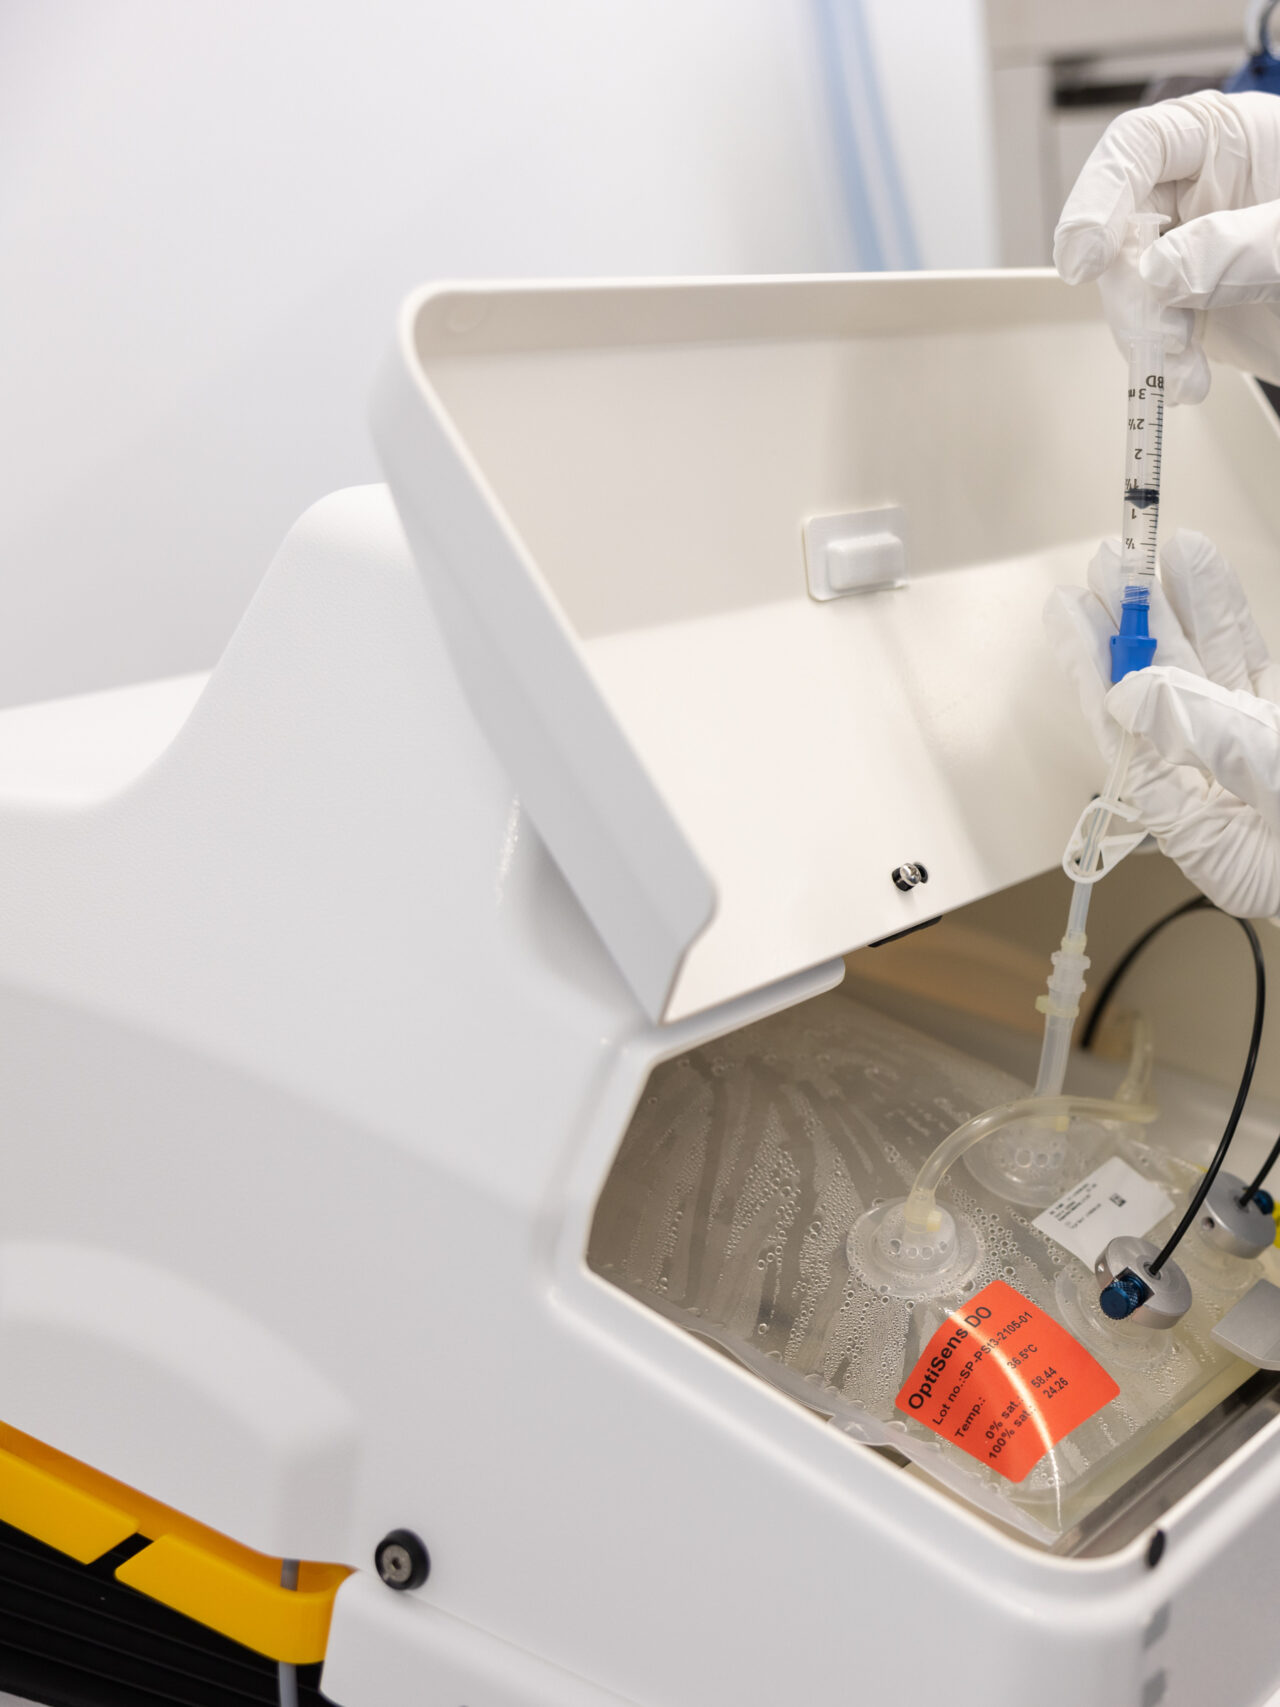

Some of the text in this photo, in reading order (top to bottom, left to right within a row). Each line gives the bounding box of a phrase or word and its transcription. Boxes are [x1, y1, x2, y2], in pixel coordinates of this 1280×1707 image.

[1145, 375, 1164, 389] BD
[1134, 448, 1143, 460] 2
[908, 1306, 993, 1410] OptiSens DO
[932, 1408, 950, 1426] Lot
[954, 1396, 987, 1439] Temp.:
[985, 1420, 1004, 1441] 0%
[1030, 1366, 1058, 1389] 58.44
[988, 1428, 1016, 1460] 100%
[1042, 1376, 1070, 1400] 24.26
